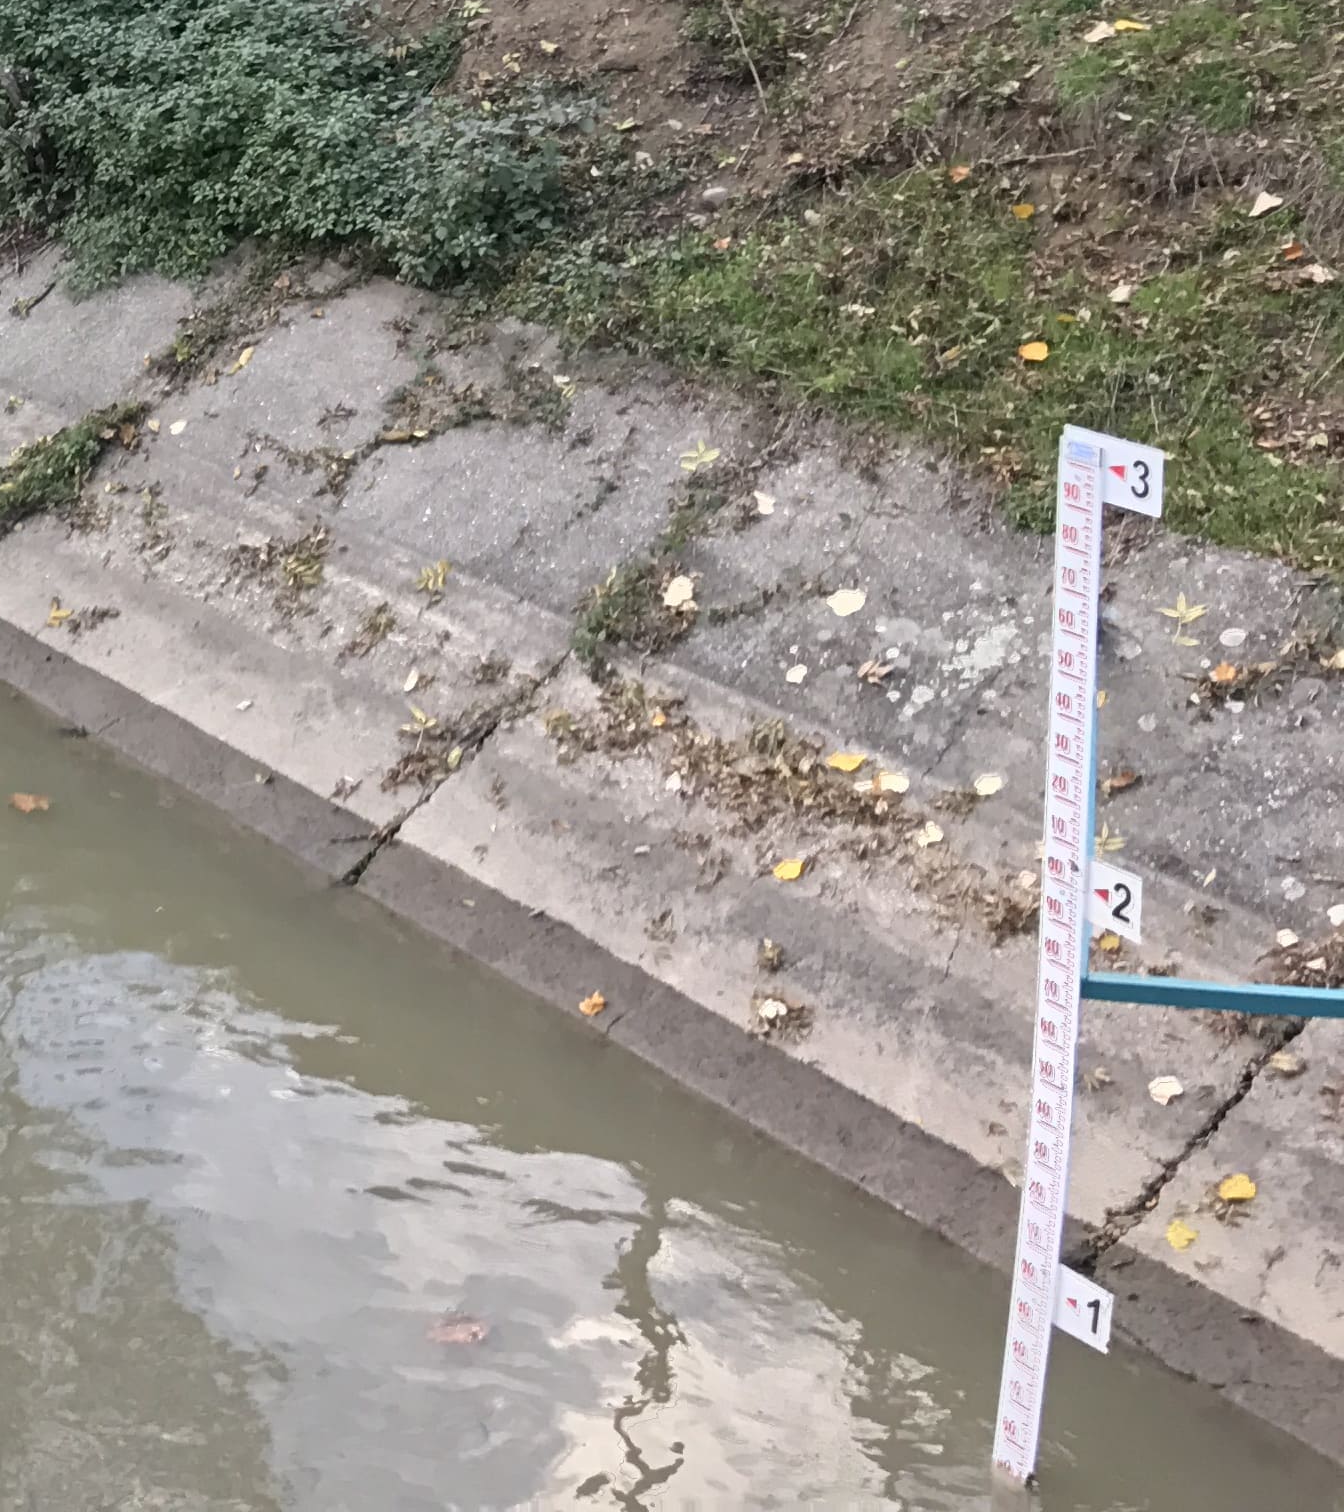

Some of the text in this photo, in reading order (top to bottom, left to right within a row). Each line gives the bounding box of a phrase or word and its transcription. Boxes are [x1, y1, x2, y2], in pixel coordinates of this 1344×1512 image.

[1131, 460, 1149, 498] 3
[1064, 482, 1079, 500] 90
[1062, 525, 1078, 544] 80
[1061, 566, 1075, 586] 70
[1059, 608, 1073, 627] 60
[1052, 775, 1067, 794] 20
[1052, 815, 1066, 835] 10
[1112, 883, 1131, 924] 2
[1087, 1299, 1100, 1334] 1
